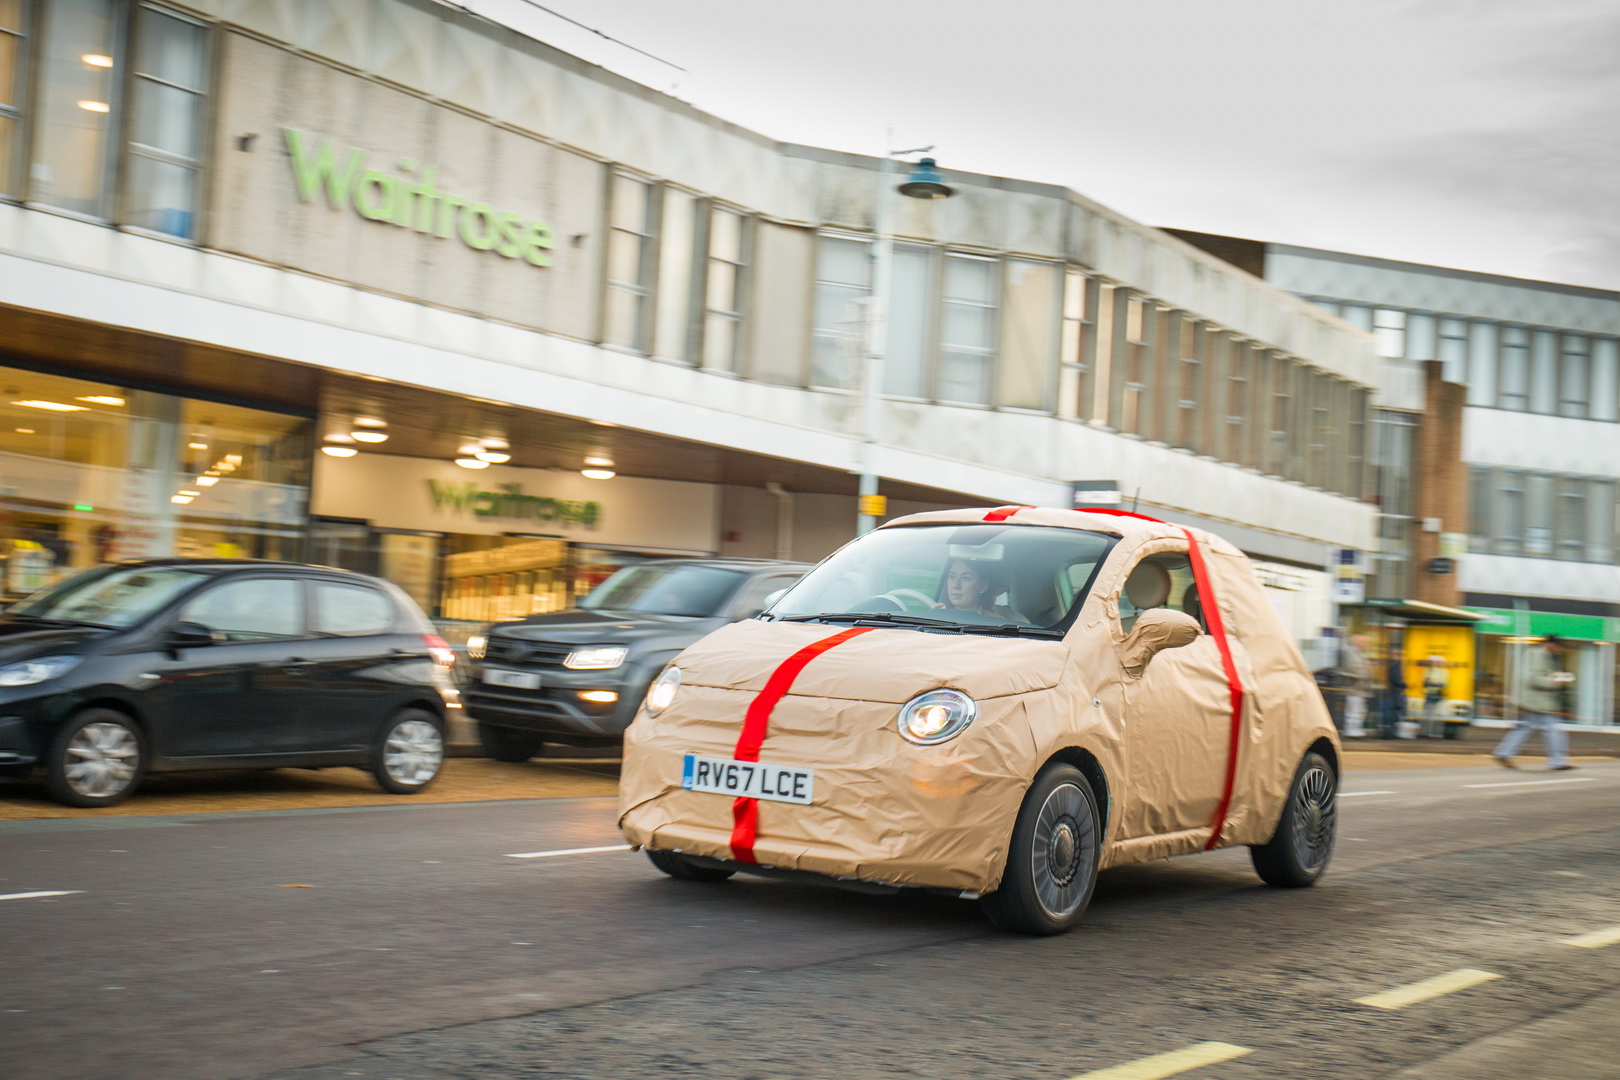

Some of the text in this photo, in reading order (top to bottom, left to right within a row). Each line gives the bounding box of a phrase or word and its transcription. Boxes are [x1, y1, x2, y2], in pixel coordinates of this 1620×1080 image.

[280, 128, 556, 268] Waitrose
[426, 479, 601, 525] Waitrose
[697, 761, 808, 798] RV67 LCE
